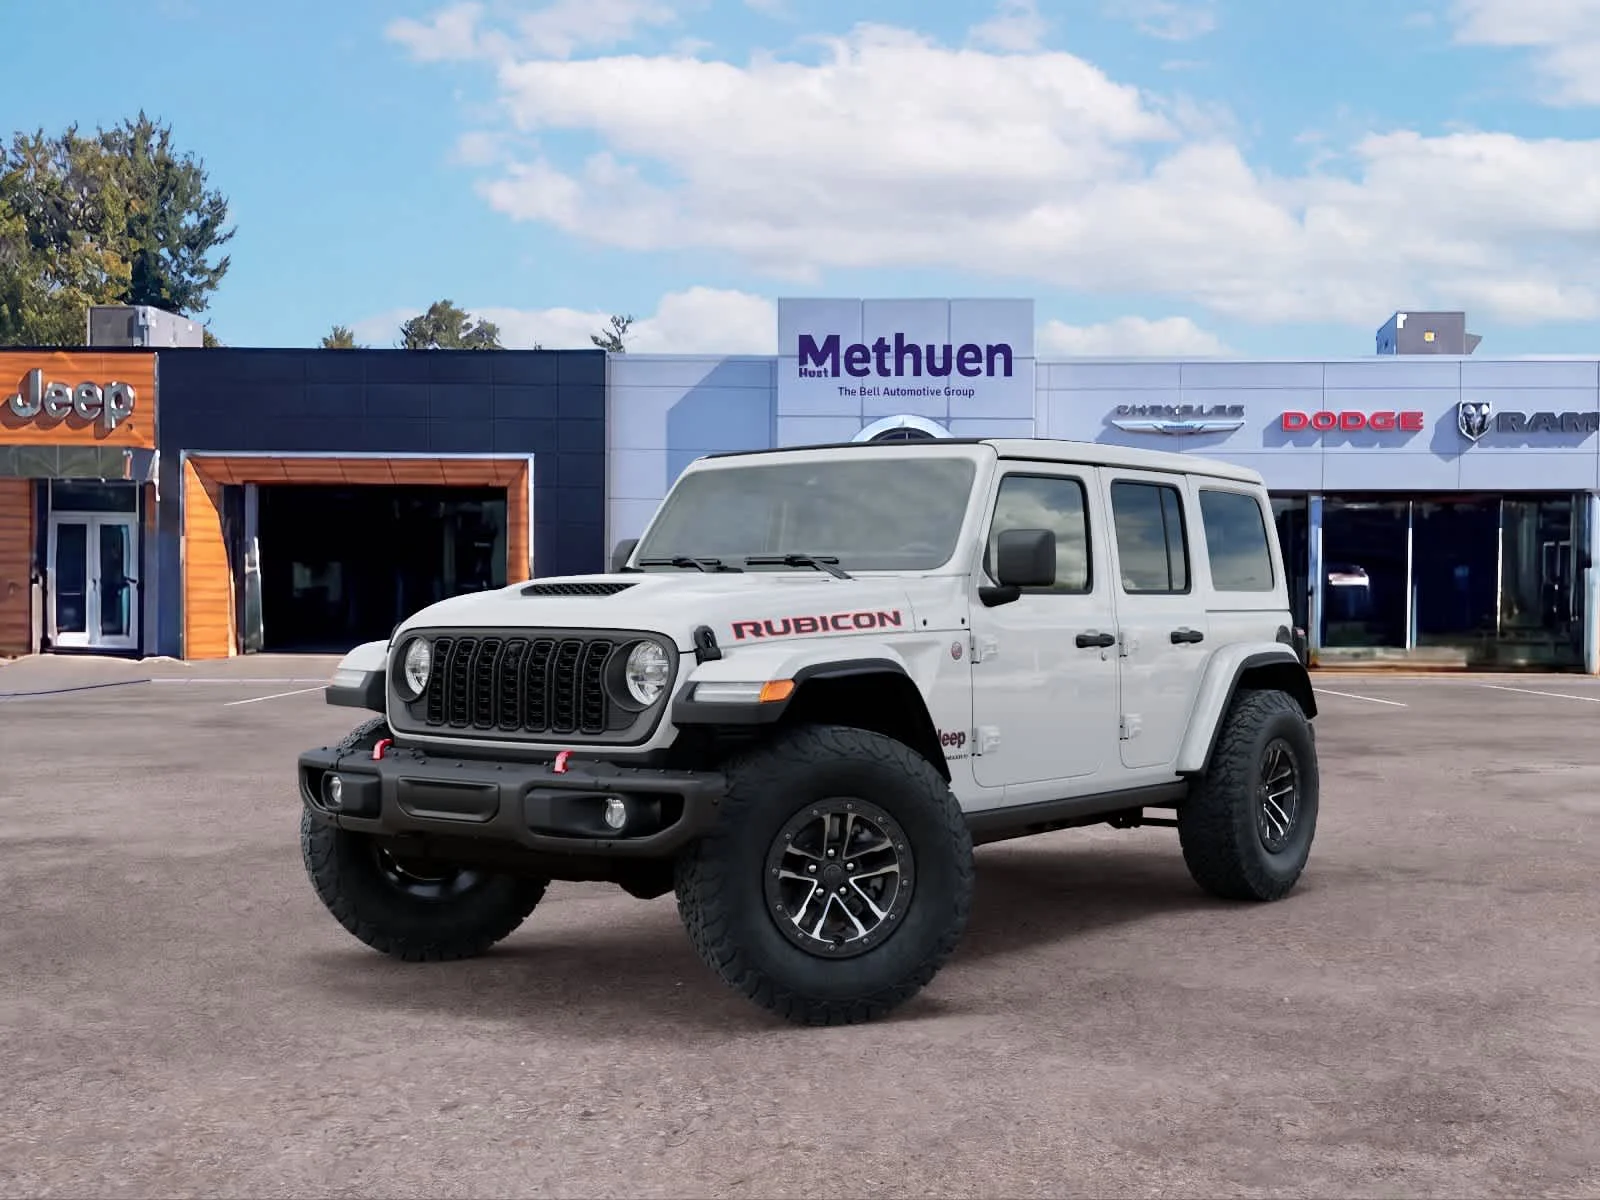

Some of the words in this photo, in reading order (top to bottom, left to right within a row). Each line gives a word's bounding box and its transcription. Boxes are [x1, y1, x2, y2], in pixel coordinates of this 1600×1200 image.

[798, 332, 1013, 378] Methuen
[9, 368, 136, 429] Jeep
[838, 386, 857, 397] The
[859, 386, 880, 397] Bell
[883, 386, 942, 397] Automotive
[943, 386, 975, 399] Group
[1282, 410, 1424, 432] DODGE
[1497, 411, 1600, 433] RAM
[731, 610, 902, 639] RUBICON
